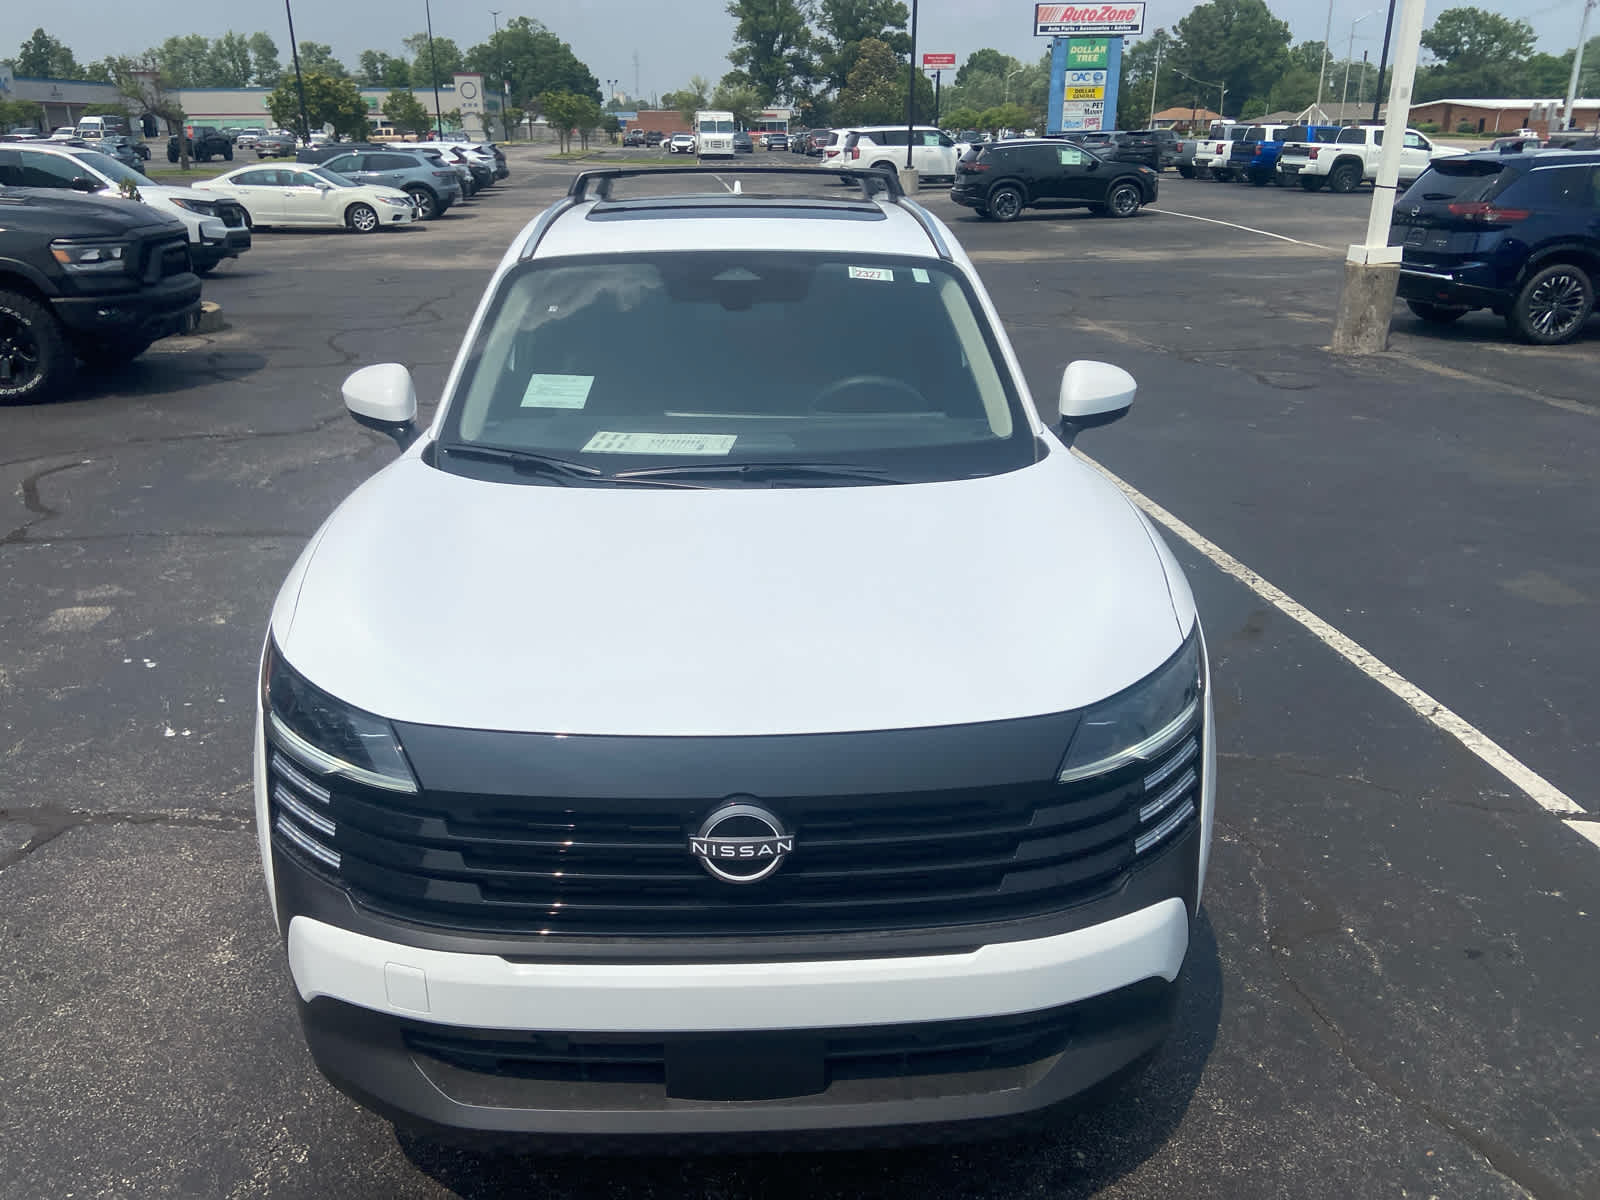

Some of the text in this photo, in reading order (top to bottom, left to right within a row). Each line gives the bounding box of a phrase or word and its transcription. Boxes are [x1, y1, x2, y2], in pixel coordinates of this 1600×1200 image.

[1060, 6, 1136, 22] AutoZone
[1070, 45, 1107, 54] DOLLAR
[1077, 54, 1099, 62] TREE
[692, 839, 792, 857] NISSAN
